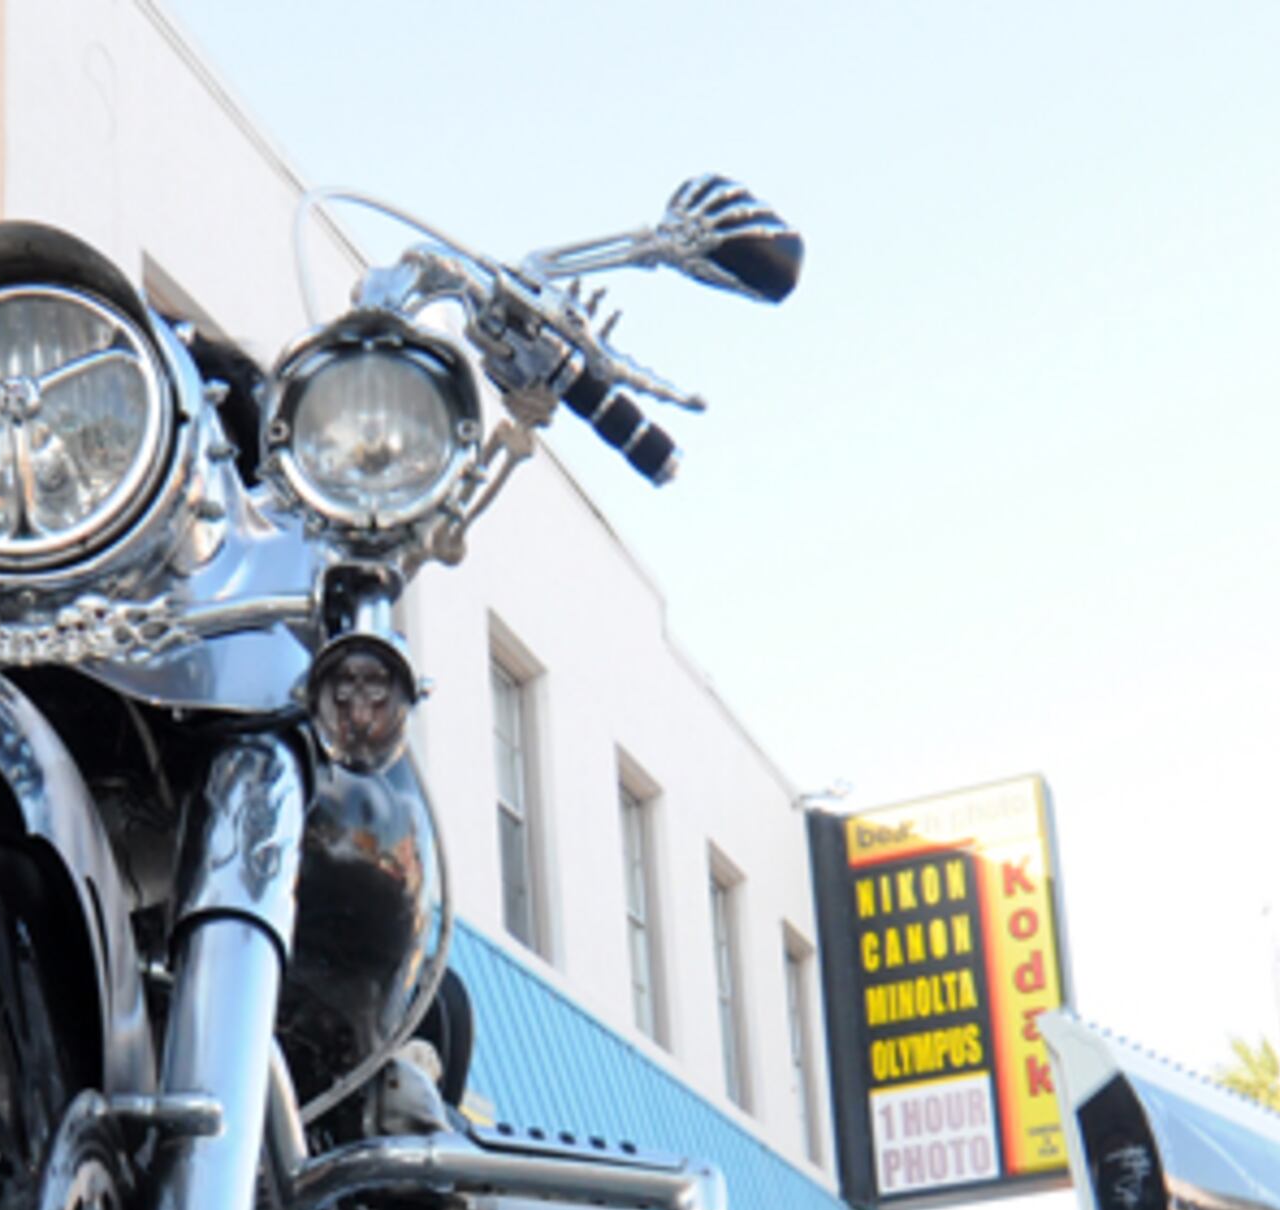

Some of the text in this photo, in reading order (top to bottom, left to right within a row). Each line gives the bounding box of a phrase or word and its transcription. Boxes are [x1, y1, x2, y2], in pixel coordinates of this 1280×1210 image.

[855, 859, 967, 919] NIKON
[861, 914, 974, 973] CANON
[865, 968, 979, 1026] MINOLTA
[871, 1022, 983, 1081] OLYMPUS
[879, 1088, 987, 1141] 1 HOUR
[882, 1135, 993, 1189] PHOTO
